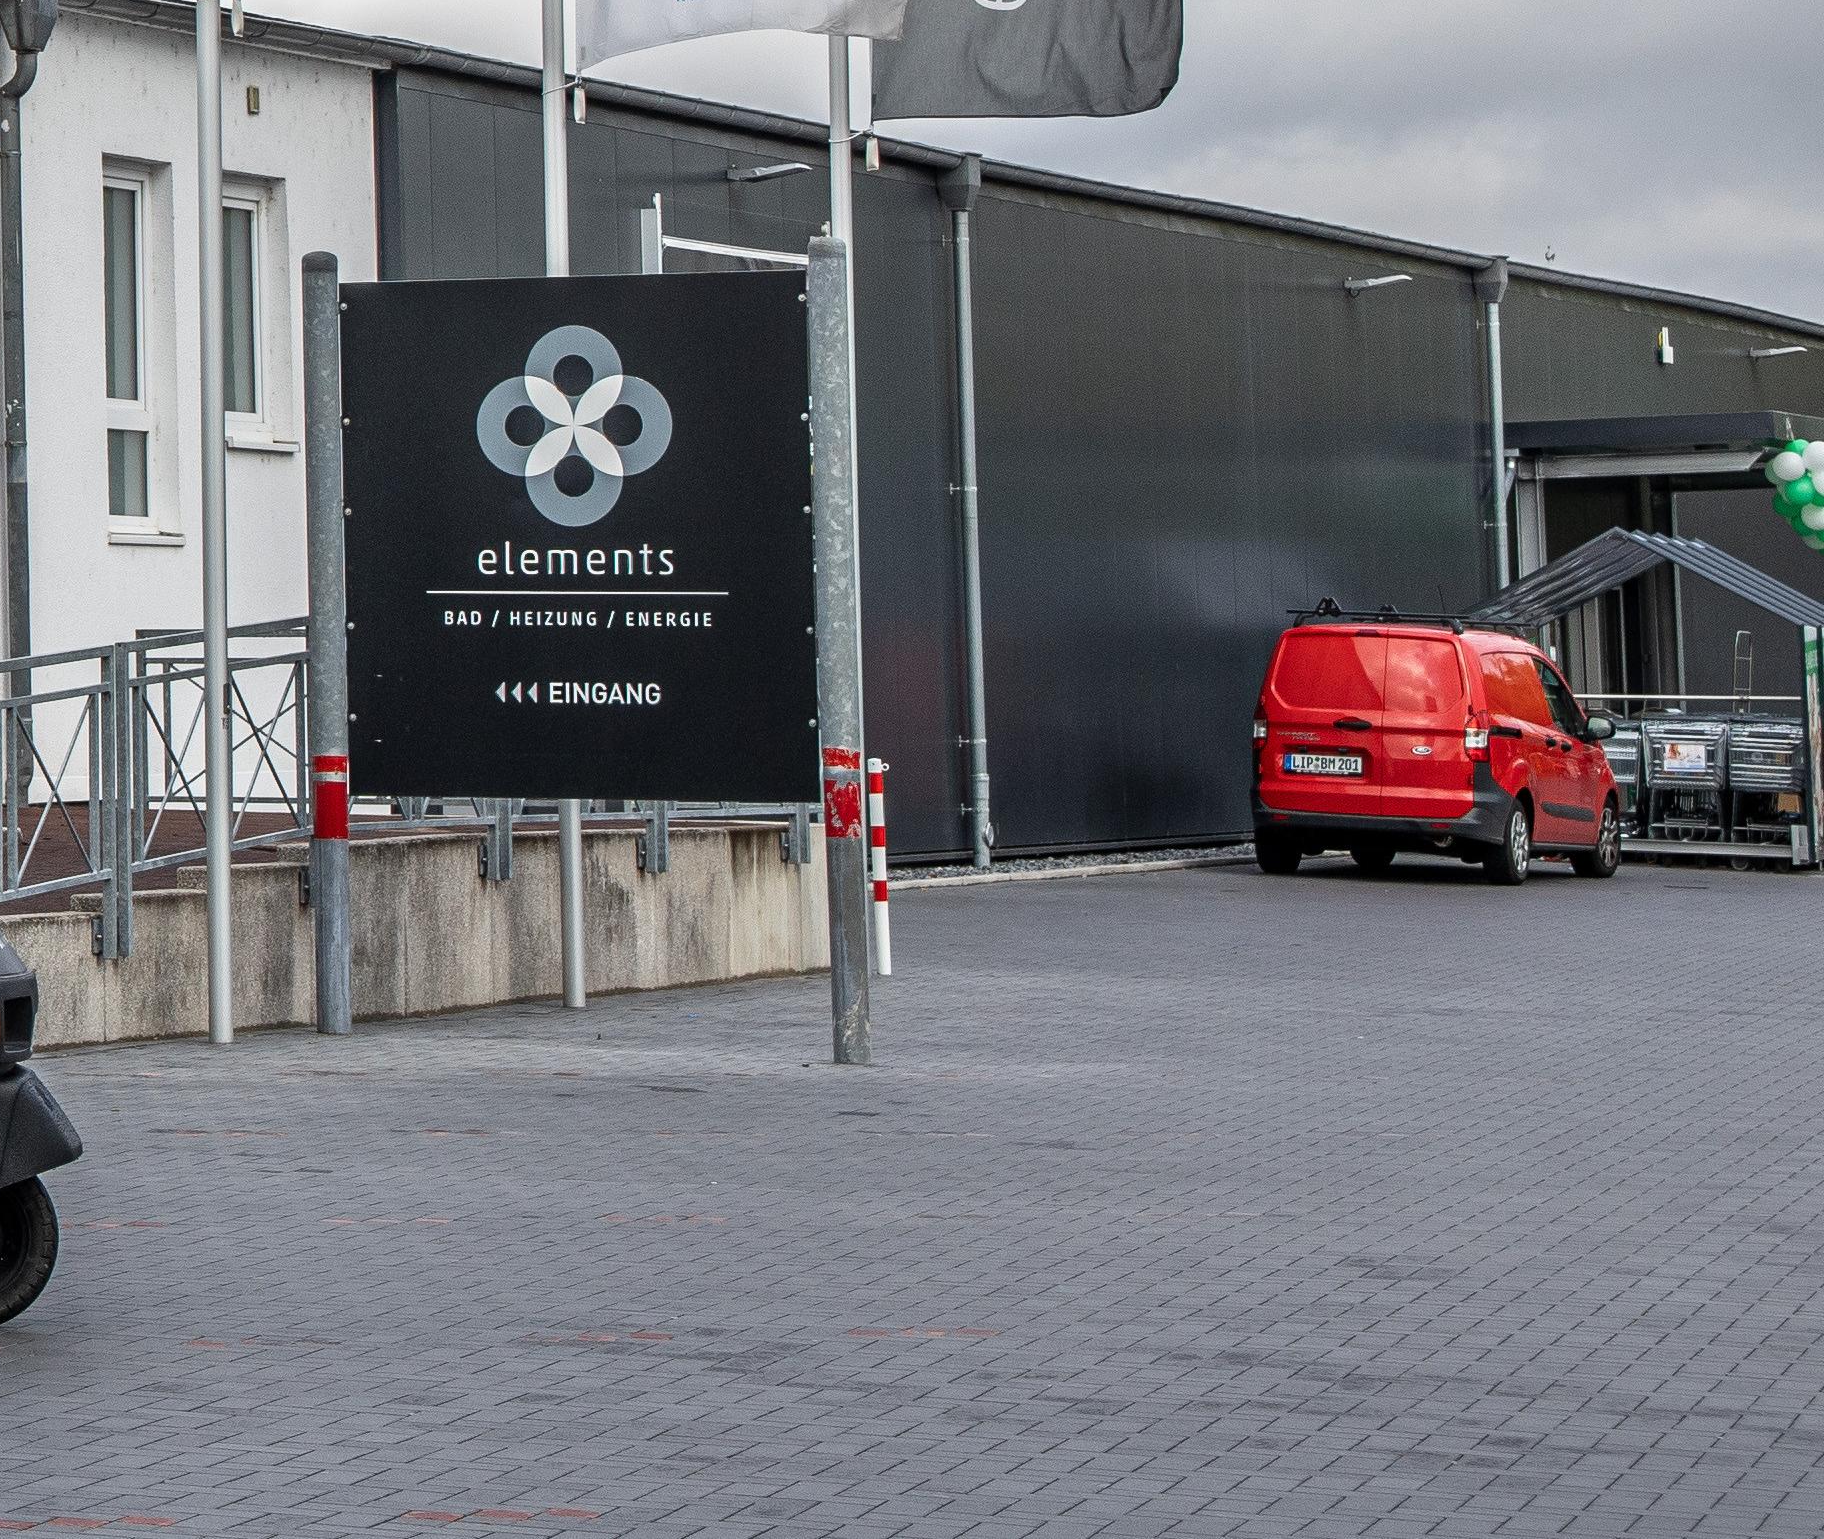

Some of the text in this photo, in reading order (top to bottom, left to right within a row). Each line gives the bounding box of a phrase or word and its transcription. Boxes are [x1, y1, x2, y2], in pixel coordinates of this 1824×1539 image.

[477, 541, 675, 576] elements
[444, 610, 483, 626] BAD
[509, 610, 598, 627] HEIZUNG
[626, 611, 713, 628] ENERGIE
[549, 682, 662, 705] EINGANG
[1292, 756, 1360, 771] LIP BM 201
